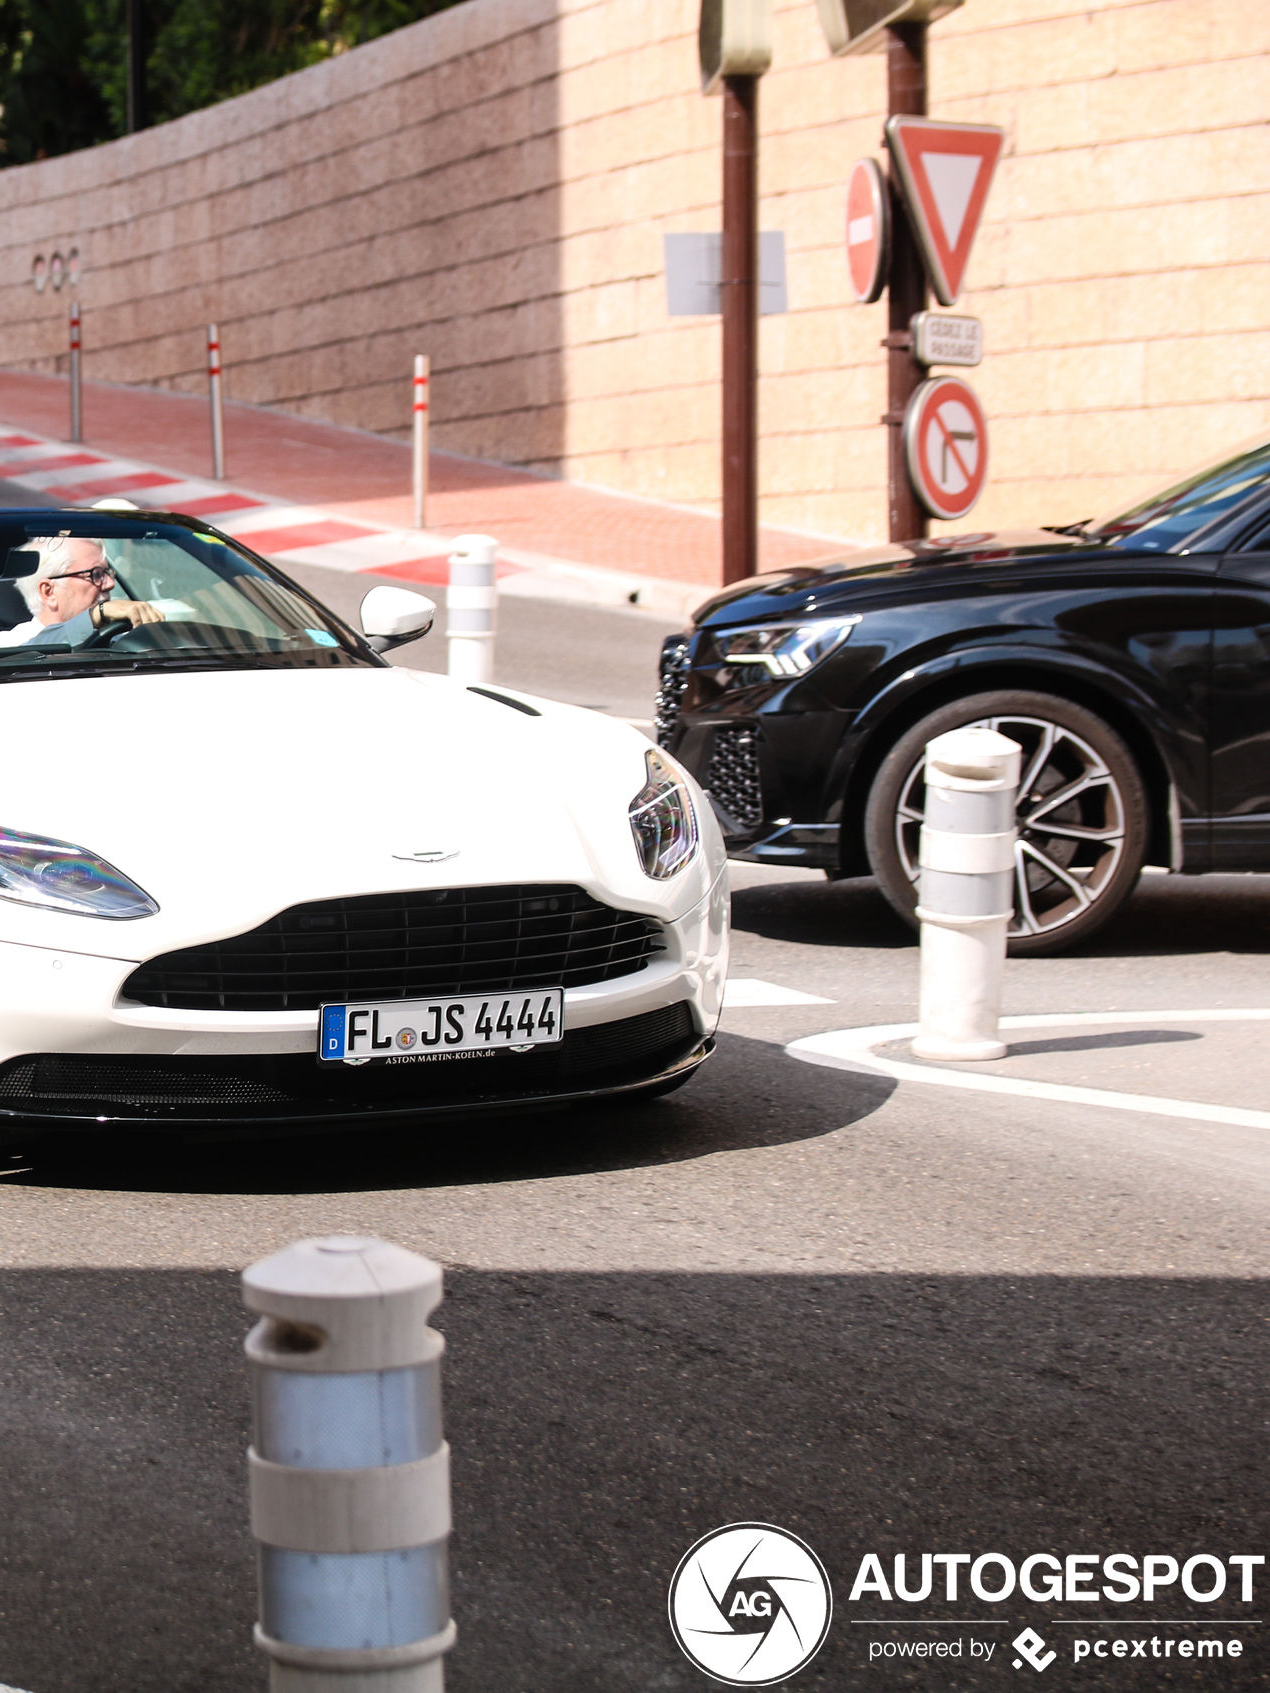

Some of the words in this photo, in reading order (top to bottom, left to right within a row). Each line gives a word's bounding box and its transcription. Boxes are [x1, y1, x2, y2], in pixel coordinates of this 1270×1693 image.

[348, 1010, 392, 1050] FL
[421, 1004, 465, 1046] JS
[474, 997, 556, 1041] 4444
[329, 1038, 338, 1050] D
[385, 1055, 416, 1065] ASTON
